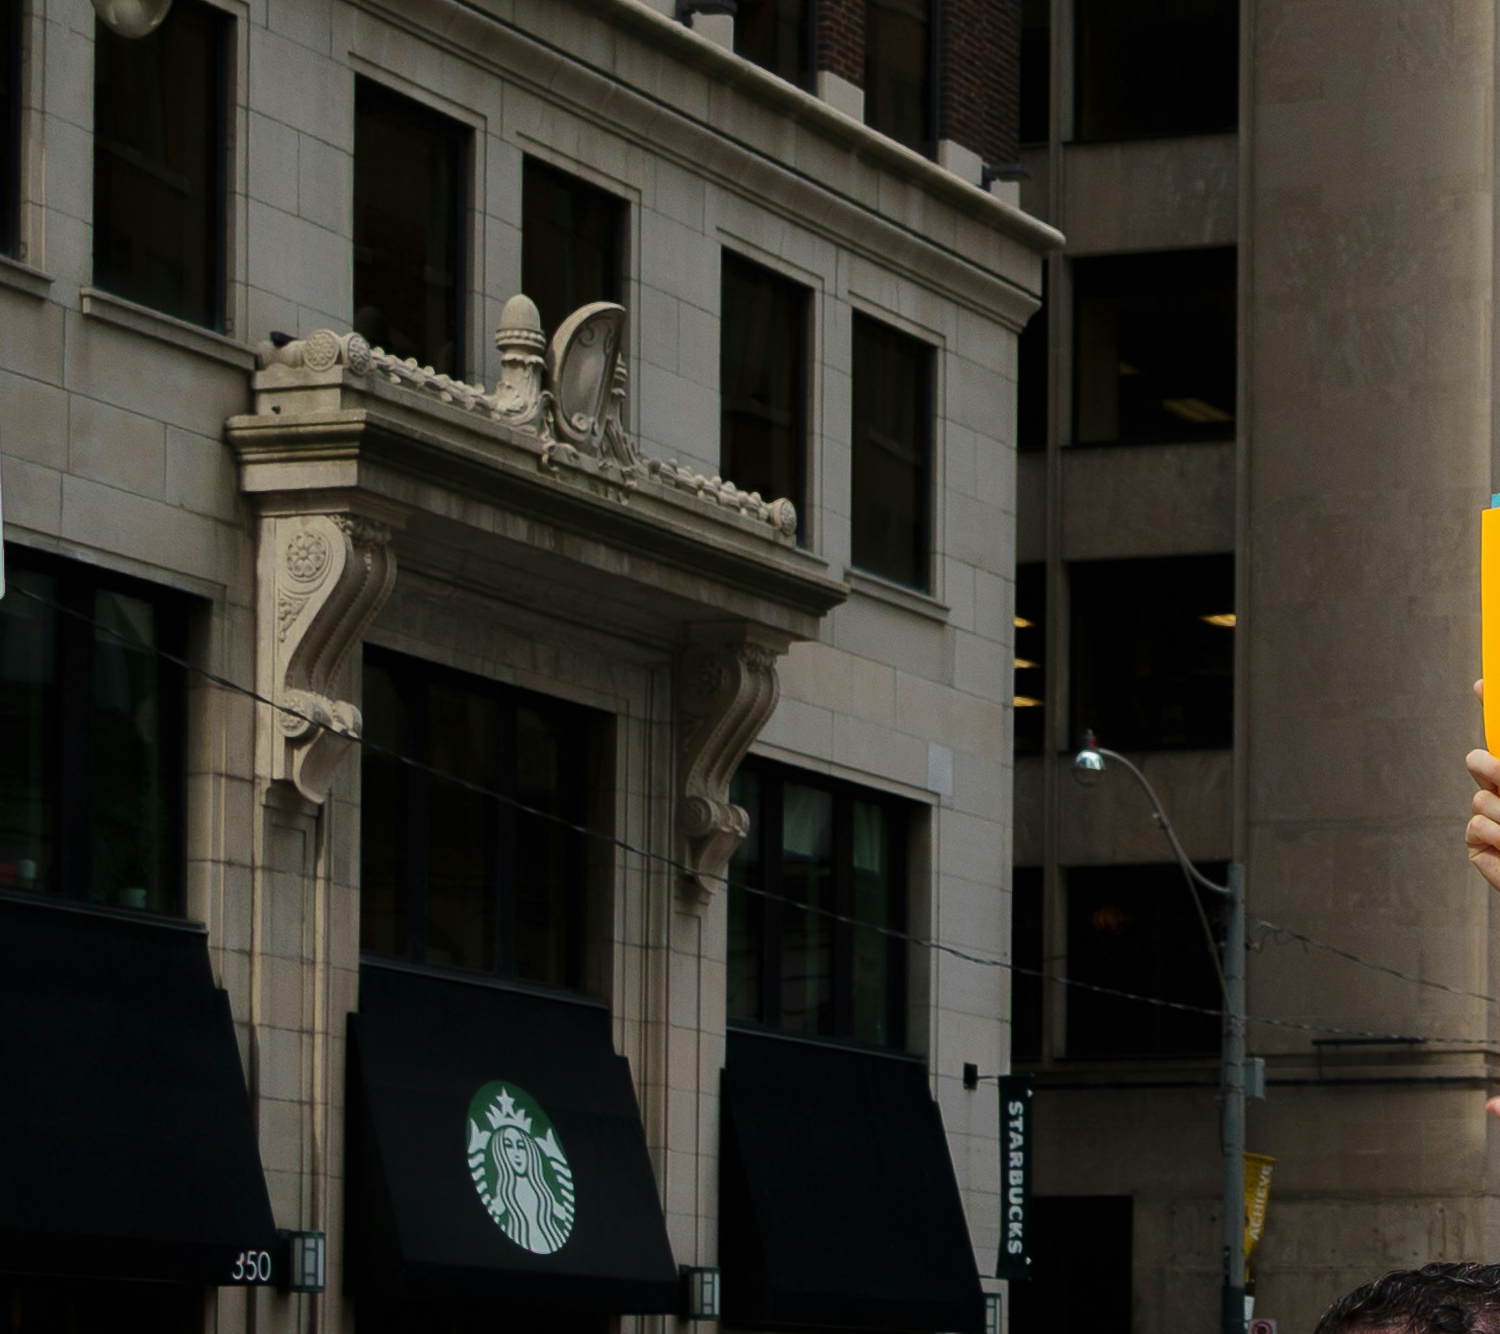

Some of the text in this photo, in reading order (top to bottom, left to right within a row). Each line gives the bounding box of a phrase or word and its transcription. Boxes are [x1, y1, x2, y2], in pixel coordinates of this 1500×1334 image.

[1008, 1101, 1025, 1255] STARBUCKS
[1250, 1165, 1273, 1241] ACHIEVE
[231, 1251, 272, 1282] 350
